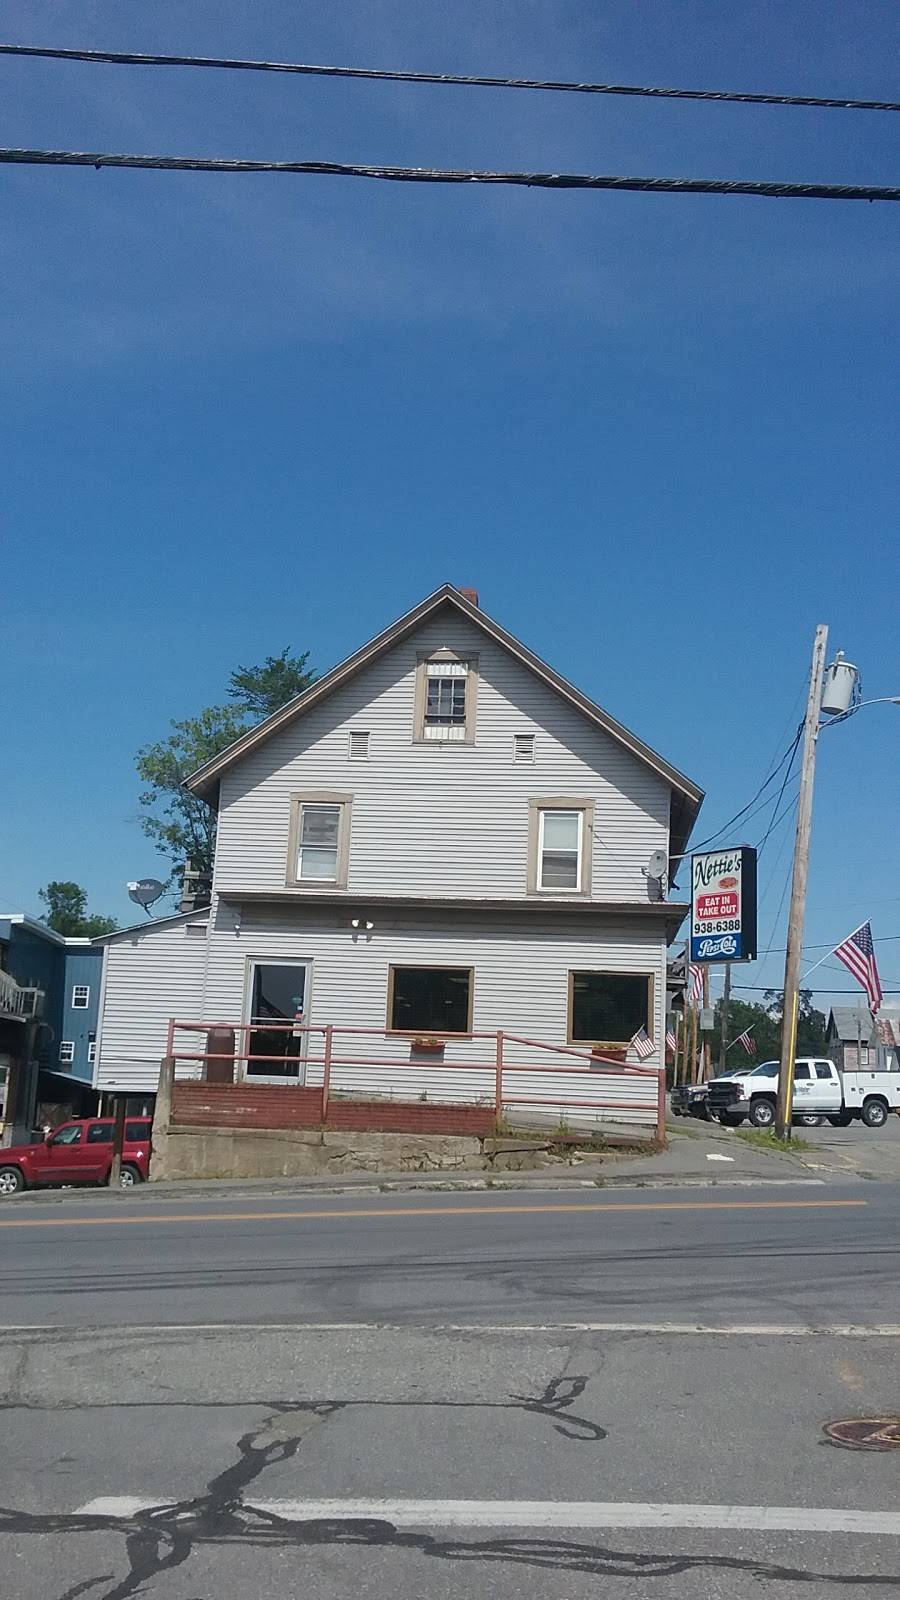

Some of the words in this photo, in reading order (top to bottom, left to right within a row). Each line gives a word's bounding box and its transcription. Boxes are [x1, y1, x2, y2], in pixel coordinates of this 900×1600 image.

[694, 854, 742, 890] Nettie's
[705, 897, 720, 907] EAT
[721, 896, 730, 905] IN
[698, 906, 718, 917] TAKE
[720, 905, 736, 914] OUT
[694, 920, 740, 934] 938-6388
